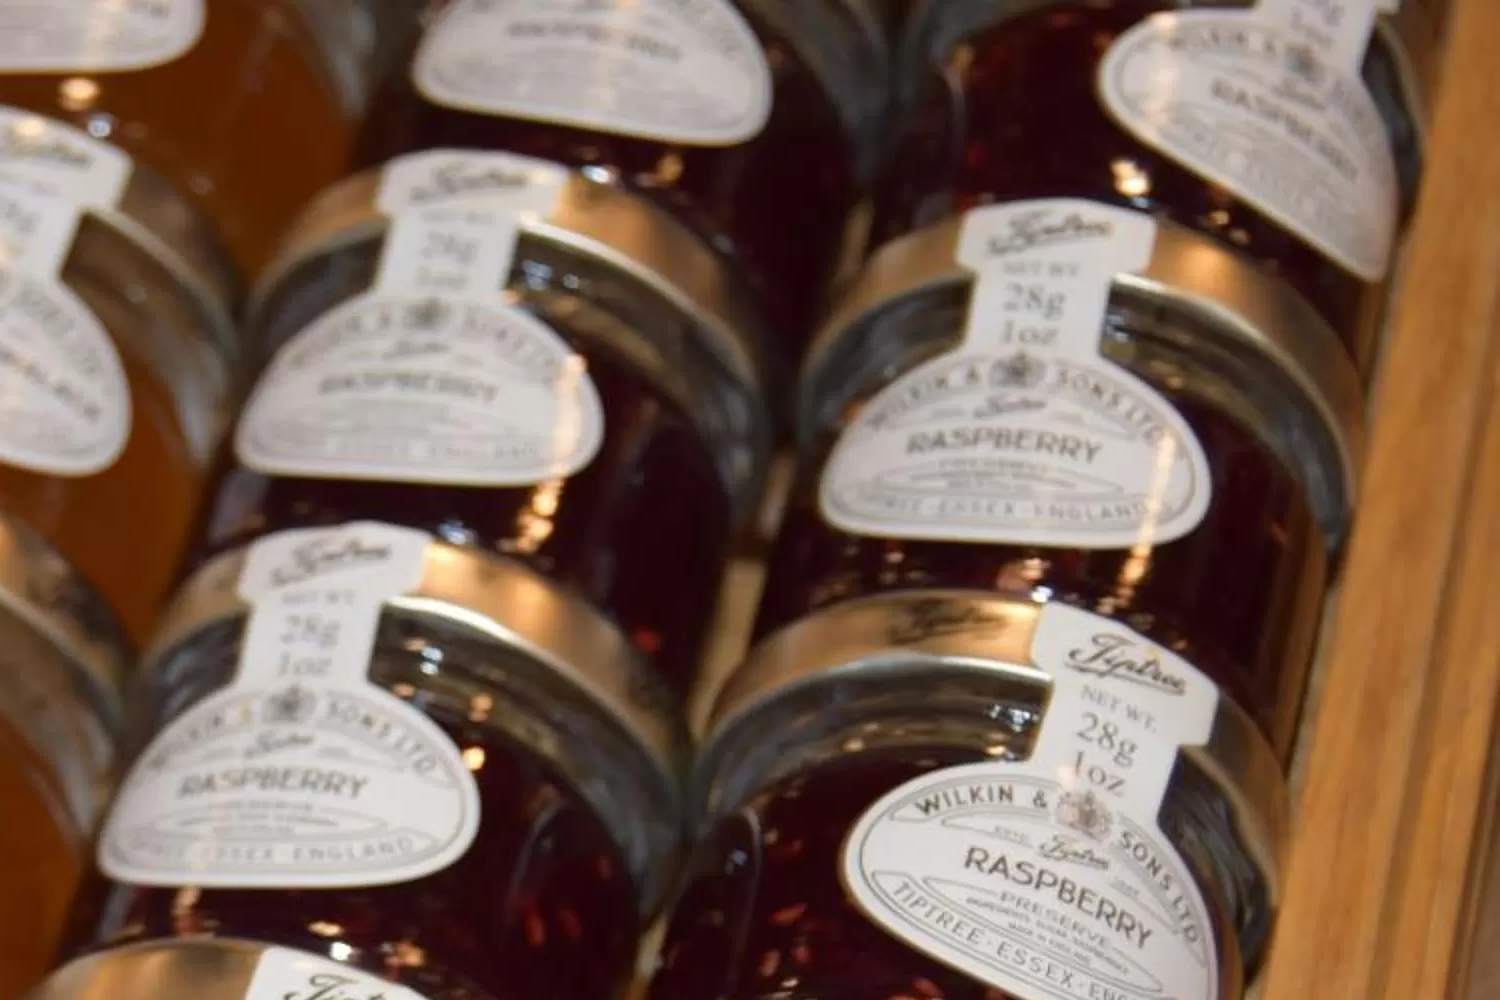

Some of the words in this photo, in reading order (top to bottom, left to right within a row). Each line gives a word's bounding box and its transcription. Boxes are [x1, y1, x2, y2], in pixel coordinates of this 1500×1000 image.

[906, 427, 1105, 465] RASPBERRY
[1075, 711, 1139, 769] 28g
[179, 765, 371, 802] RASPBERRY
[1071, 750, 1125, 797] 1oz
[915, 785, 1014, 818] WILKIN
[1032, 790, 1049, 810] &
[1117, 830, 1173, 892] SONS
[1171, 890, 1200, 945] LTD
[964, 846, 1153, 950] RASPBERRY
[893, 878, 982, 948] TIPTREE
[997, 941, 1074, 989] ESSEX
